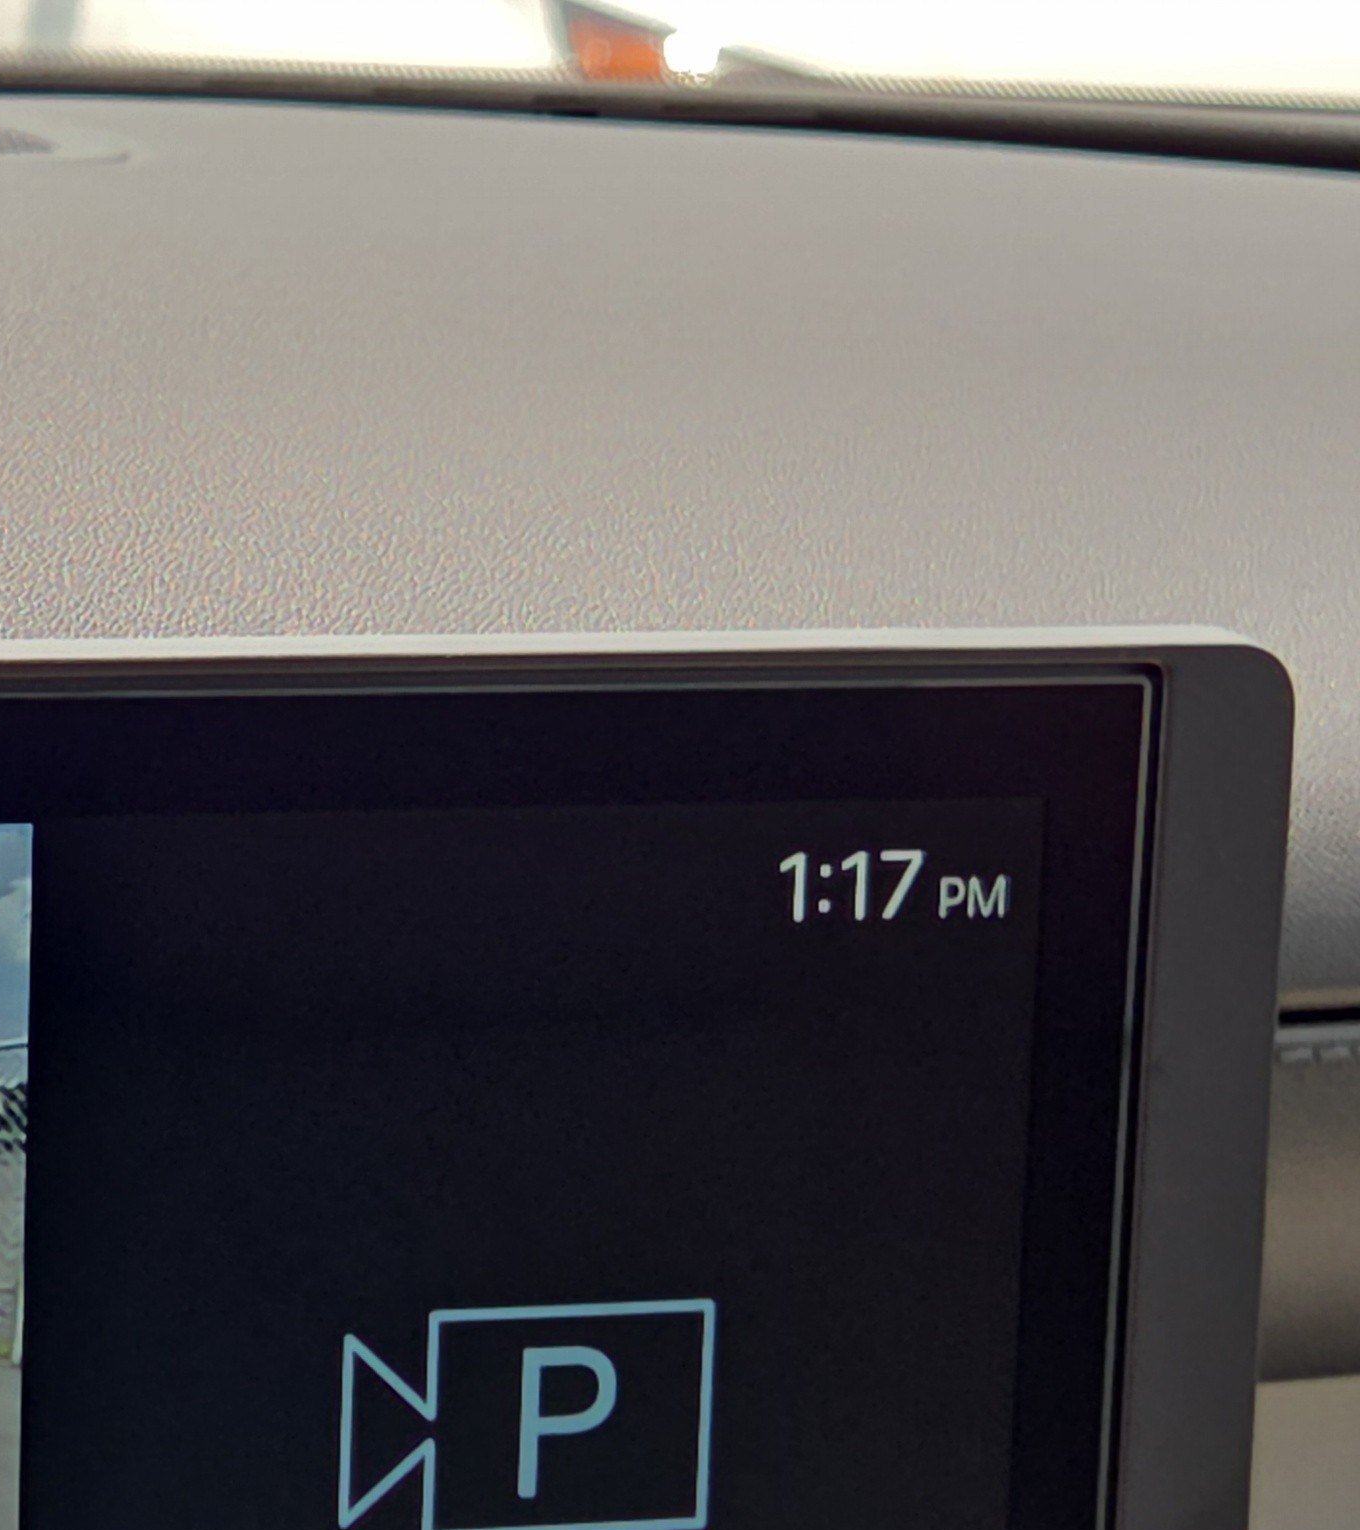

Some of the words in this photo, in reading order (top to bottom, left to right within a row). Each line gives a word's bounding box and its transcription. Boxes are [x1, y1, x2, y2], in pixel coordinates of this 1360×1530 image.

[779, 849, 926, 923] 1:17
[938, 873, 1010, 919] PM
[516, 1345, 618, 1499] P
